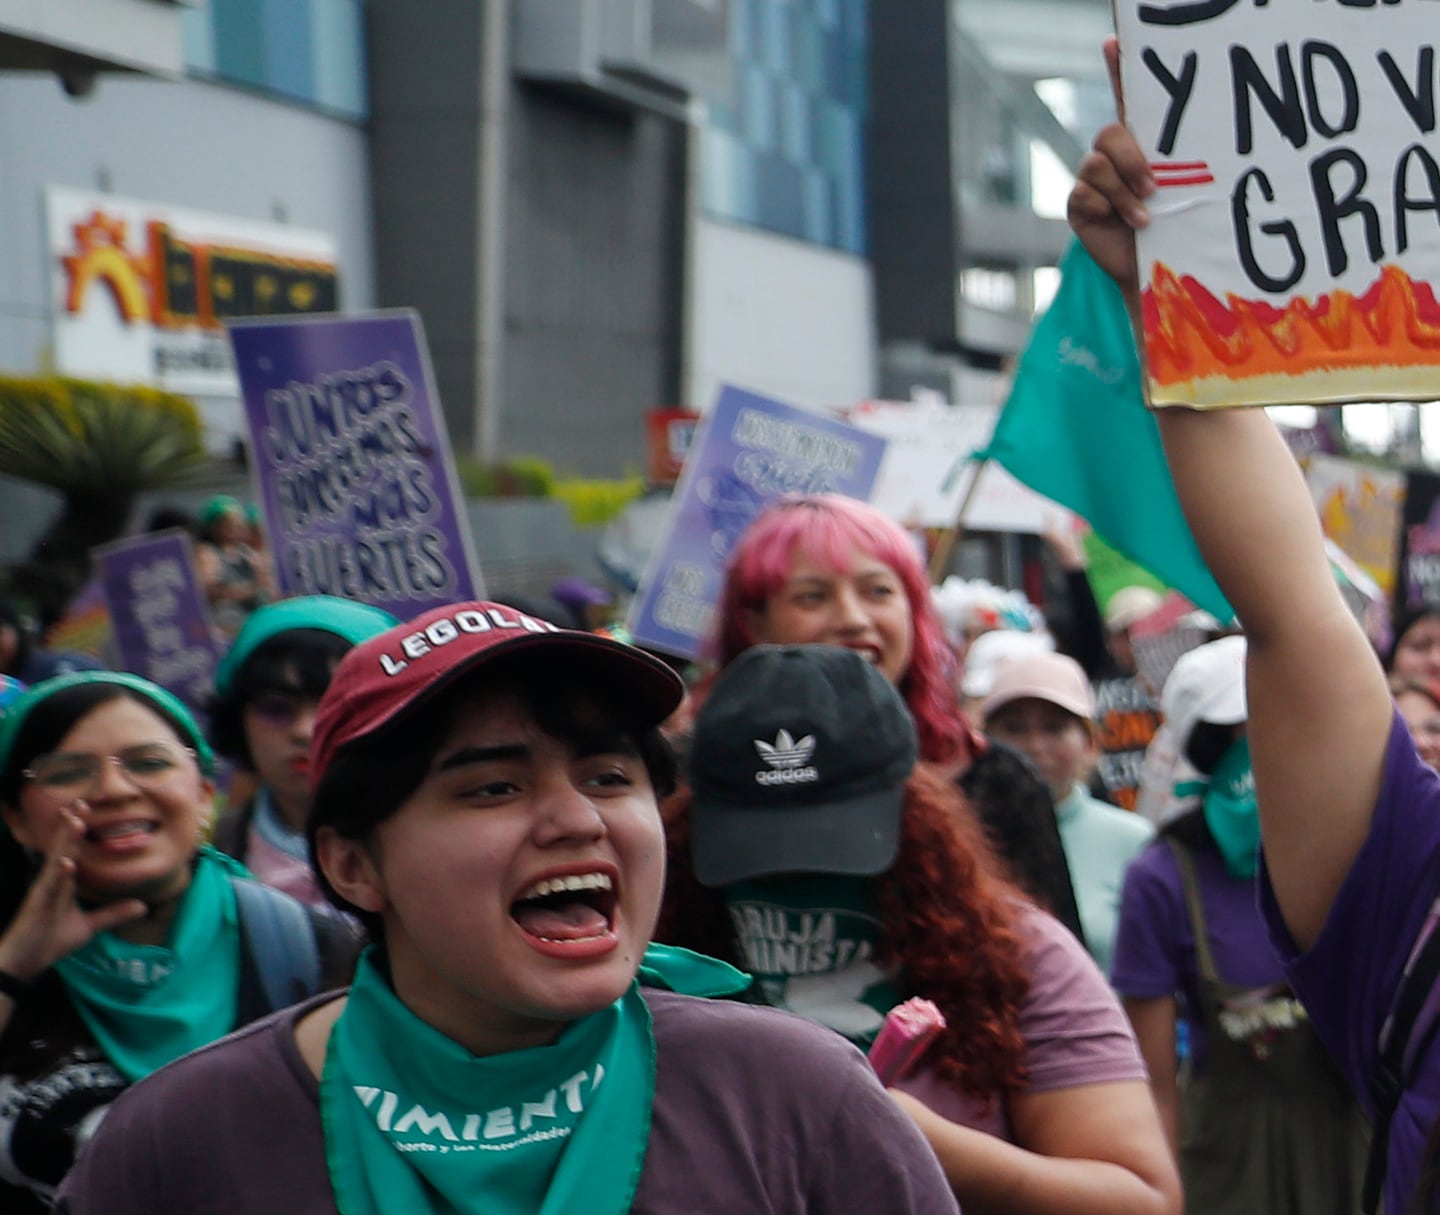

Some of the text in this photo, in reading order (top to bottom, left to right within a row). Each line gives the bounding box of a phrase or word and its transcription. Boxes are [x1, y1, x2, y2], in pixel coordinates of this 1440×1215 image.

[1141, 46, 1198, 155] Y
[1229, 38, 1361, 155] NO
[755, 765, 819, 786] adidas
